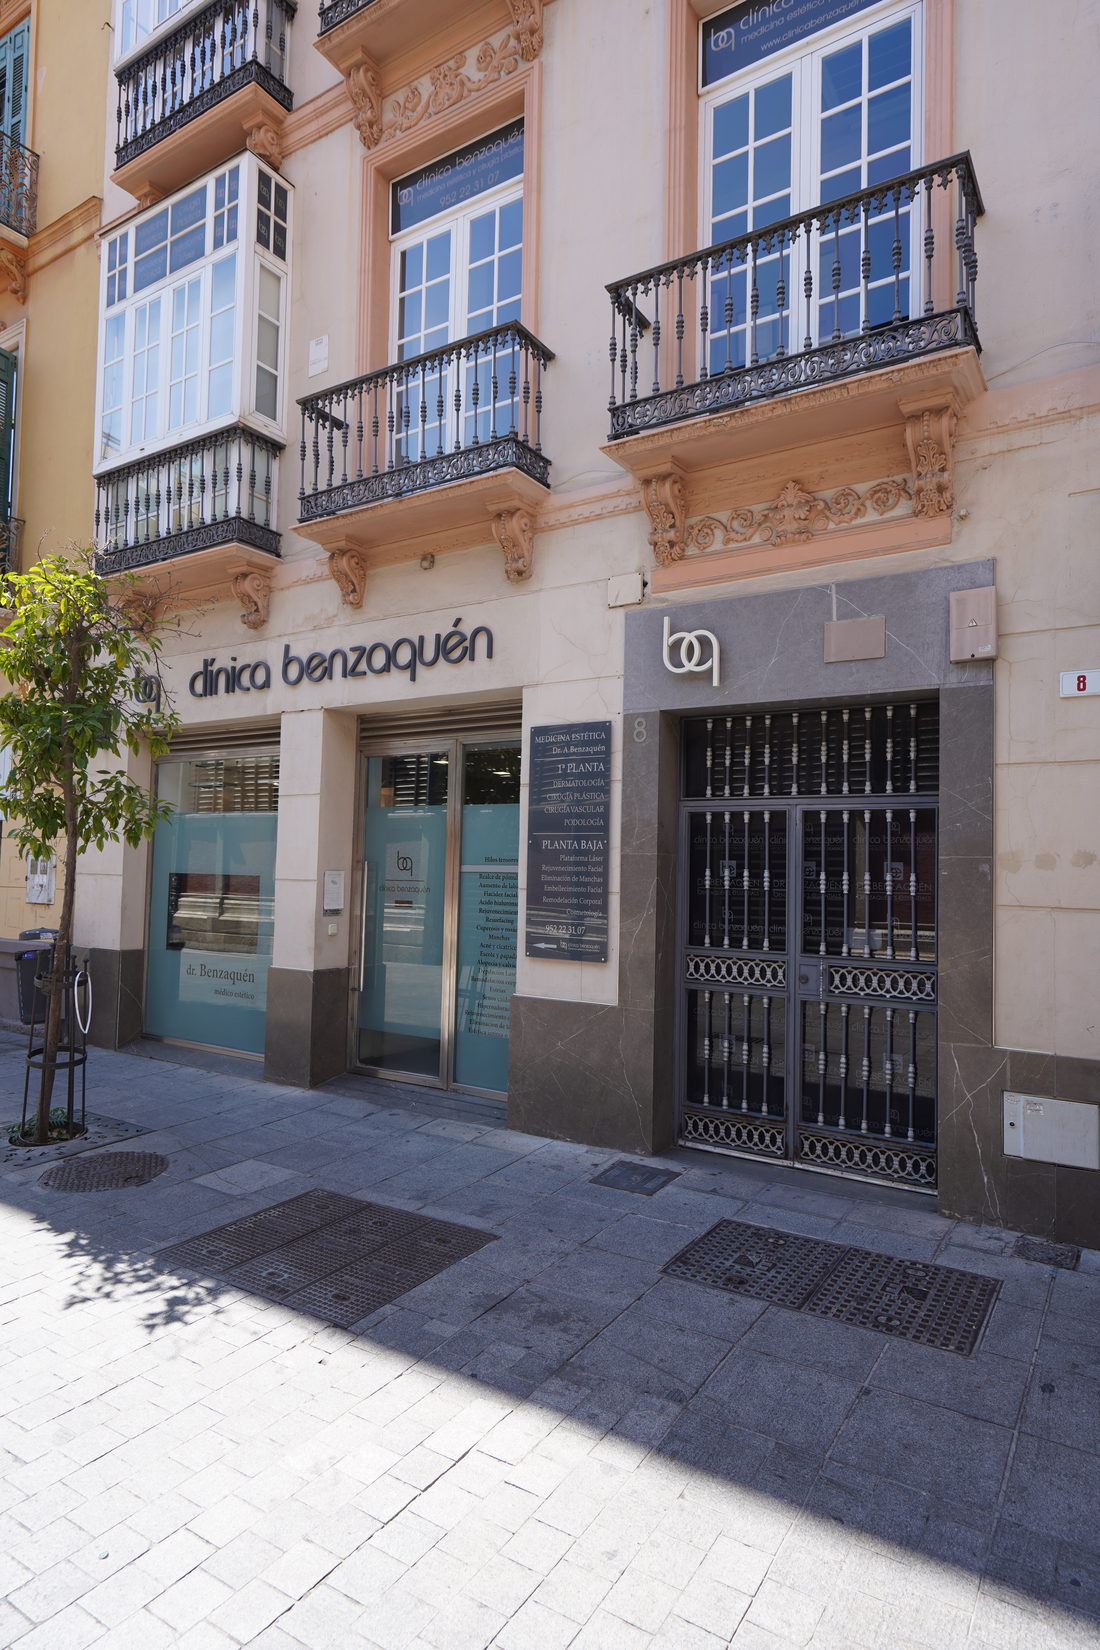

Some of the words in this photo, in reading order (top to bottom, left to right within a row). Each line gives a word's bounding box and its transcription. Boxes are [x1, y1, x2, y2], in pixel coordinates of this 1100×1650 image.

[662, 616, 720, 686] bq
[189, 657, 272, 698] clínica
[281, 618, 494, 686] benzaquén
[1076, 675, 1086, 692] 8
[634, 718, 646, 742] 8
[535, 734, 570, 744] MEDICINA
[572, 731, 606, 741] ESTÉTICA
[567, 762, 605, 772] PLANTA
[553, 779, 605, 788] DERMATOLOGÍA
[573, 791, 605, 800] PLÁSTICA
[570, 805, 604, 813] VASCULAR
[564, 818, 604, 826] PODOLOGÍA
[542, 840, 579, 850] PLANTA
[581, 840, 604, 851] BAJA
[560, 854, 588, 862] Plataforma
[589, 854, 603, 862] Láser
[541, 865, 587, 873] Rejuvenecimiento
[542, 896, 578, 904] Remodelación
[580, 898, 602, 906] Corporal
[546, 924, 558, 933] 952
[558, 925, 567, 934] 22
[568, 926, 576, 934] 31
[577, 926, 586, 934] 07
[186, 964, 196, 976] dr.
[200, 964, 255, 984] Benzaquén
[214, 988, 233, 997] médico
[234, 992, 255, 1000] estético
